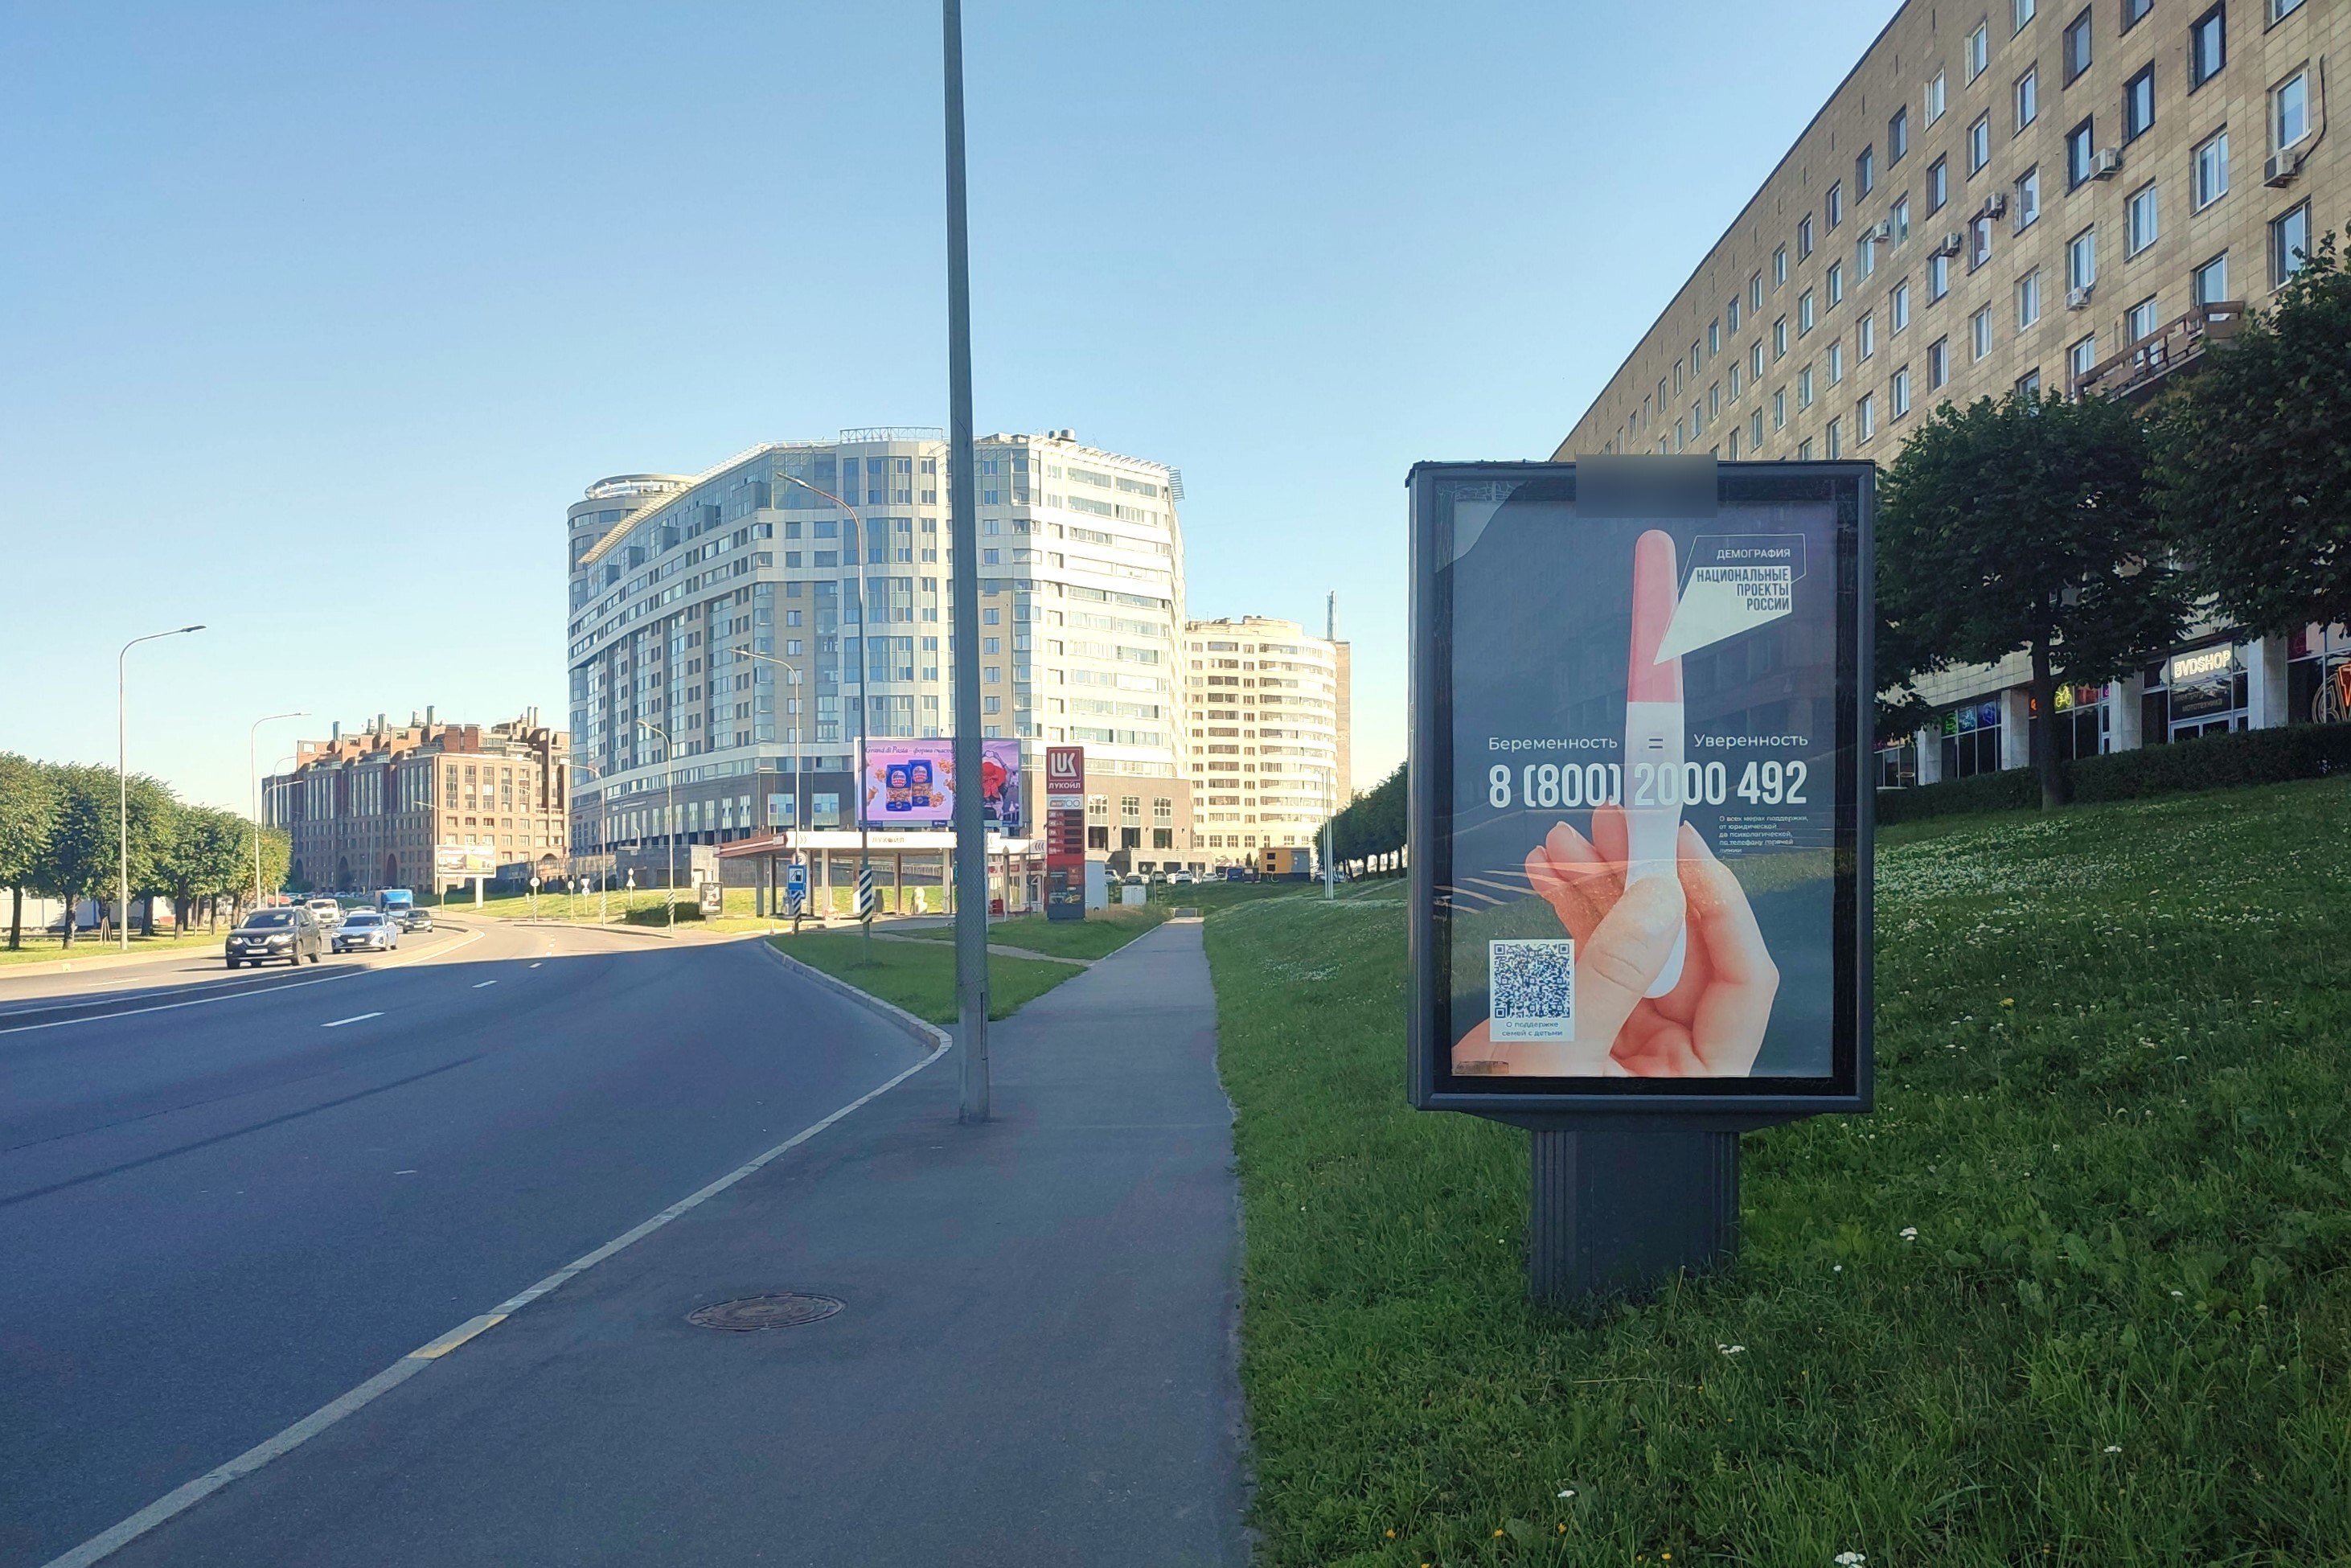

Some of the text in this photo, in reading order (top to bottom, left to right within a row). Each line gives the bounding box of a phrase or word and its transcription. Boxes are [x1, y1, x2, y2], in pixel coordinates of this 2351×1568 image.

[1716, 548, 1791, 560] ДЕМОГРАФИЯ
[1697, 568, 1789, 584] НАЦИОНАЛЬНЫЕ
[1737, 583, 1789, 597] ПРОЕКТЫ
[1746, 597, 1790, 611] РОССИИ
[2173, 650, 2231, 679] BVDSHOP
[865, 745, 884, 754] Grand
[892, 745, 909, 754] Pasta
[1488, 737, 1619, 753] Беременность
[1693, 733, 1809, 749] Уверенность
[1048, 781, 1081, 790] ЛУКОЙЛ
[1489, 760, 1807, 808] 8 (800) 2000 492
[1729, 839, 1764, 847] телефону
